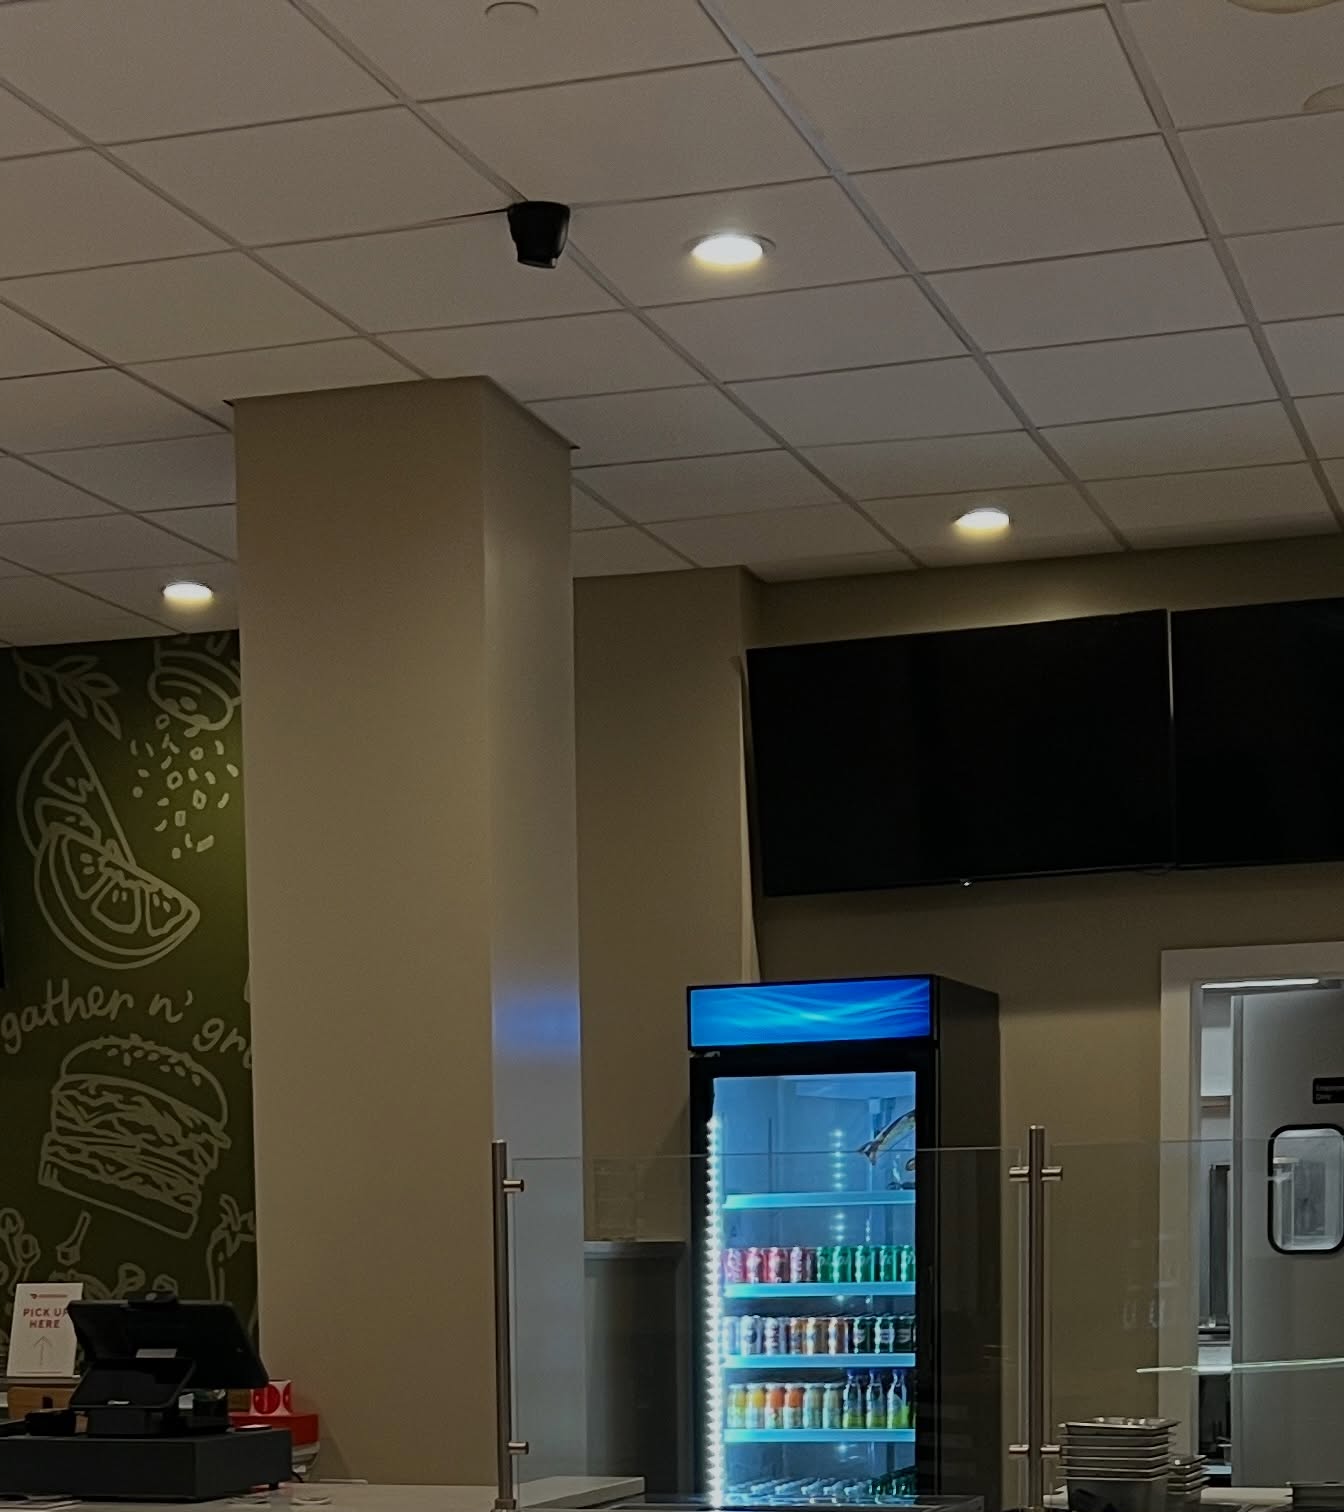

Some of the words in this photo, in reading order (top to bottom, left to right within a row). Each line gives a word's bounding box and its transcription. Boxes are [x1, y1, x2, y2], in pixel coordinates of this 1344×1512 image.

[1, 978, 134, 1054] gather
[23, 1308, 50, 1317] PICK
[29, 1319, 60, 1328] HERE
